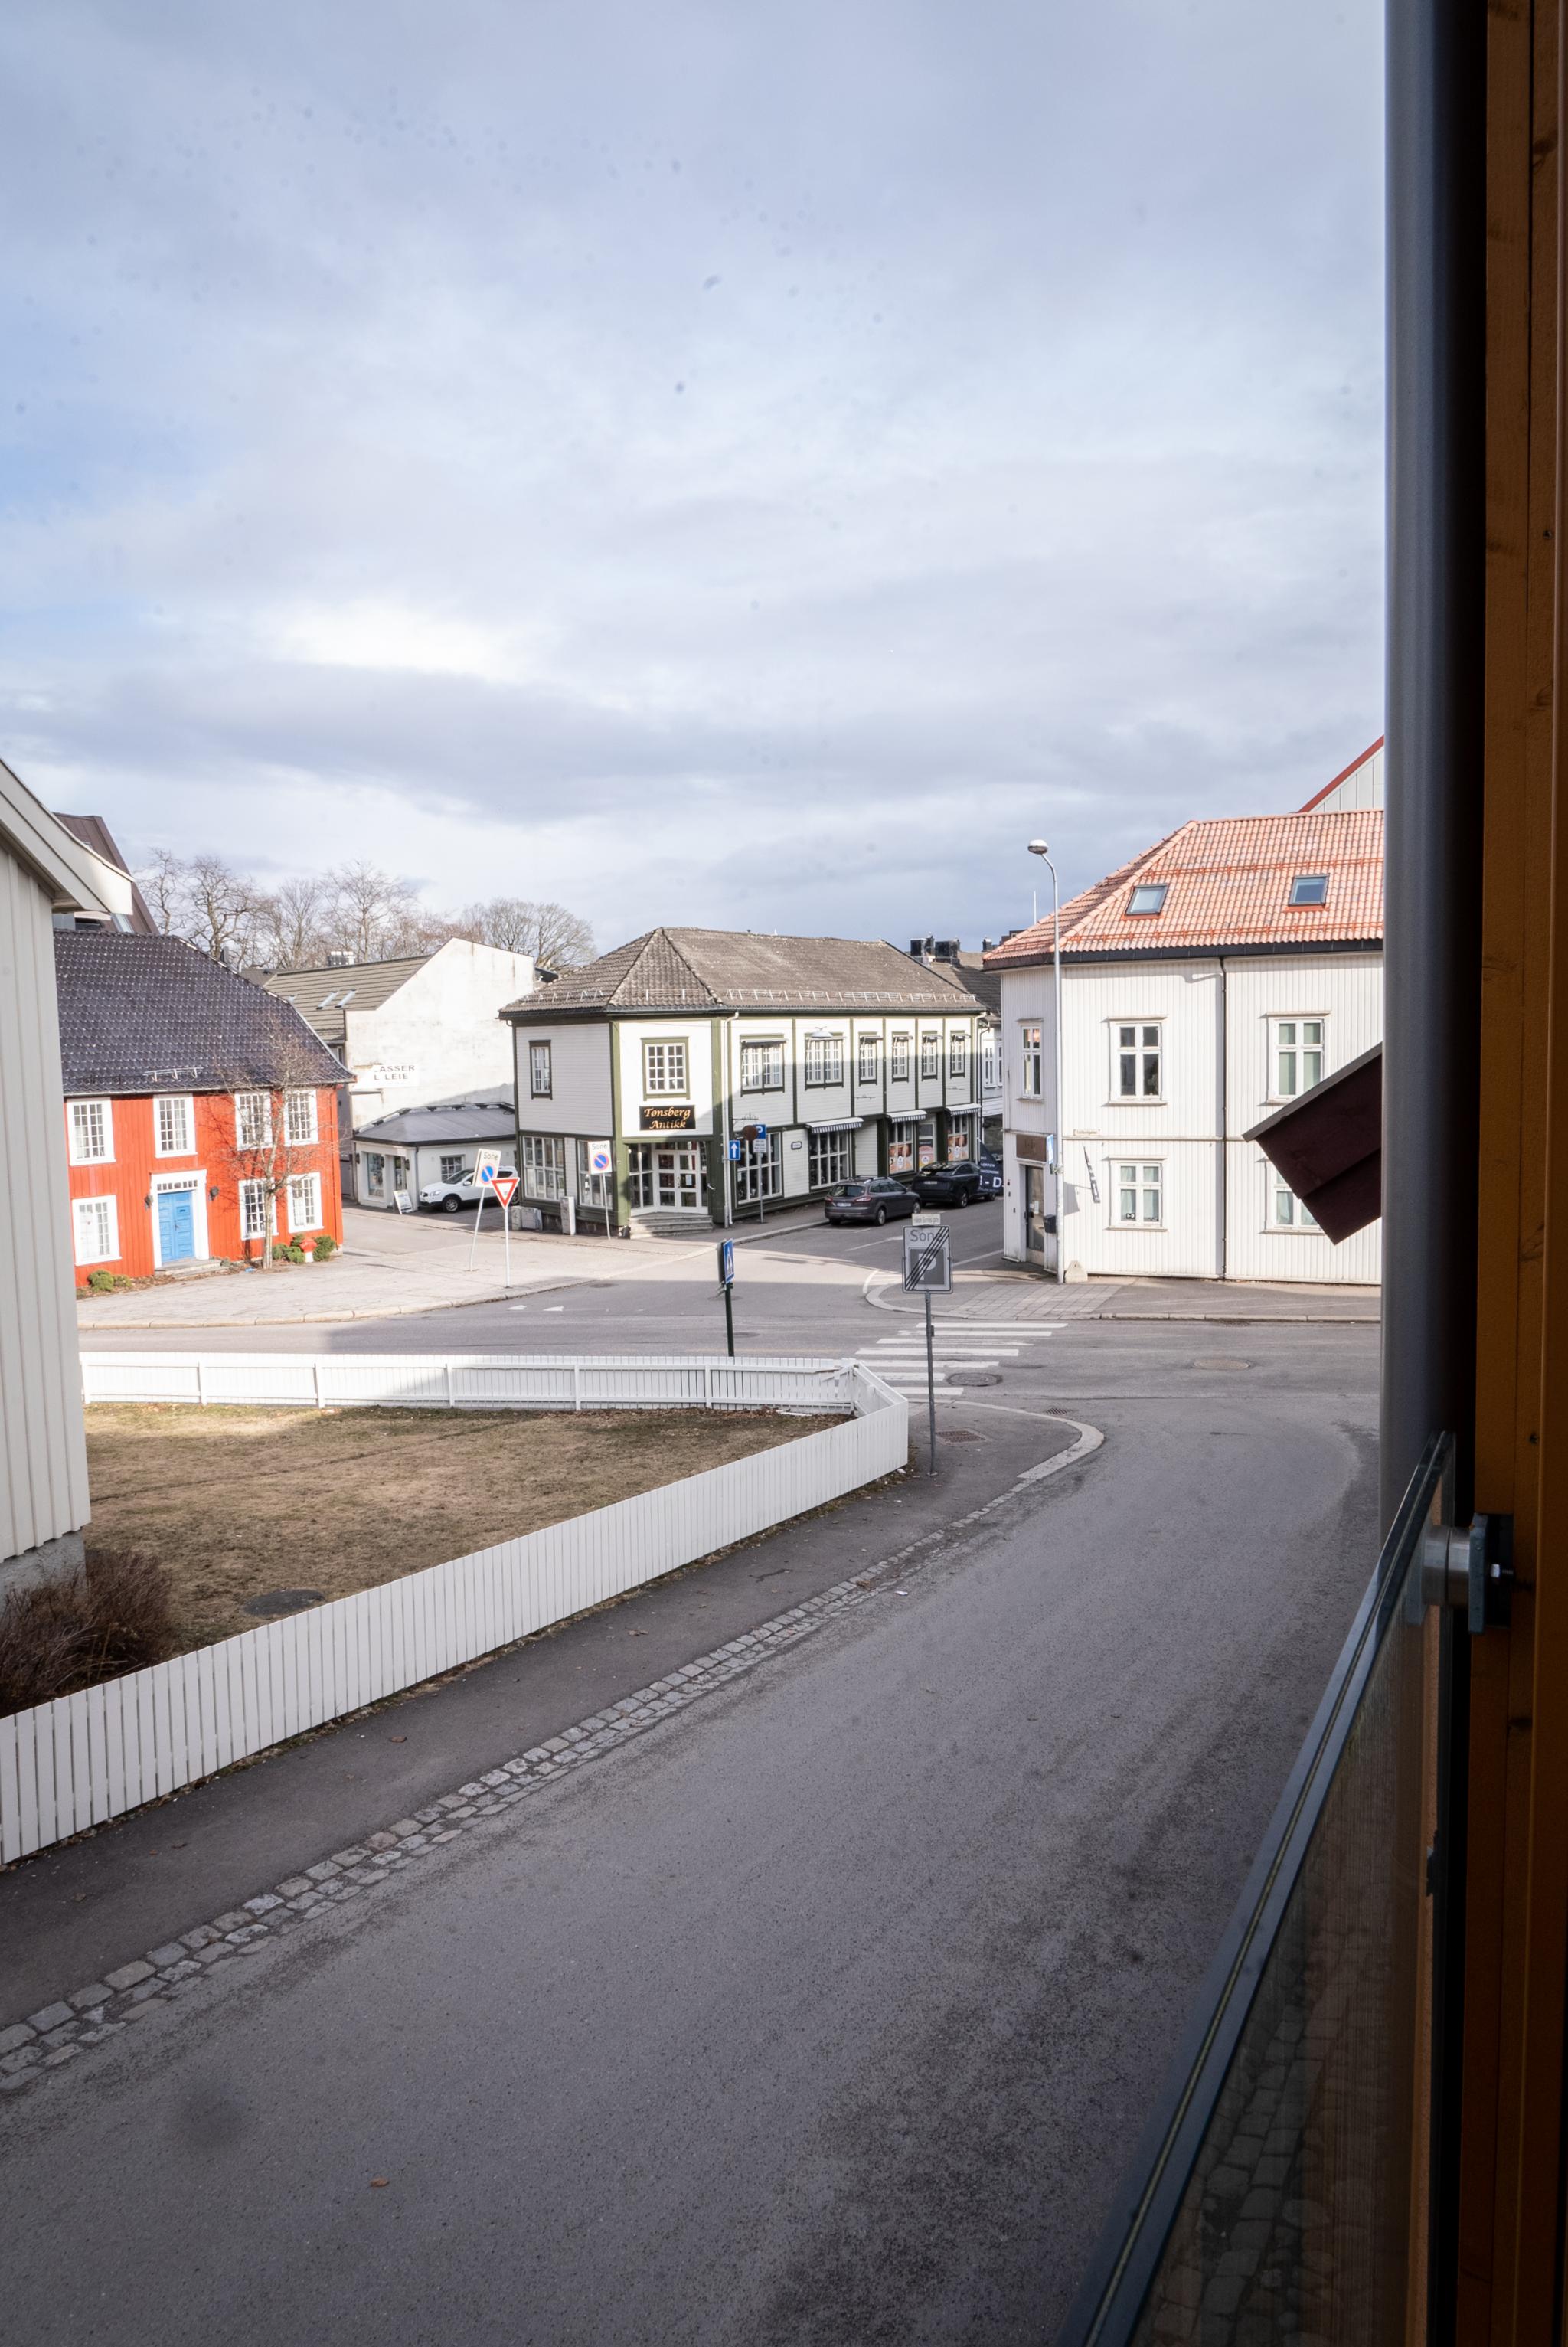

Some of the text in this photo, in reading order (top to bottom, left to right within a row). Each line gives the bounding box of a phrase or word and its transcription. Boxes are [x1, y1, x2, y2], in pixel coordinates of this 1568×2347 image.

[644, 1106, 691, 1120] Tønsberg
[649, 1118, 686, 1129] Antikk
[483, 1151, 498, 1160] Sone
[910, 1229, 943, 1242] Son
